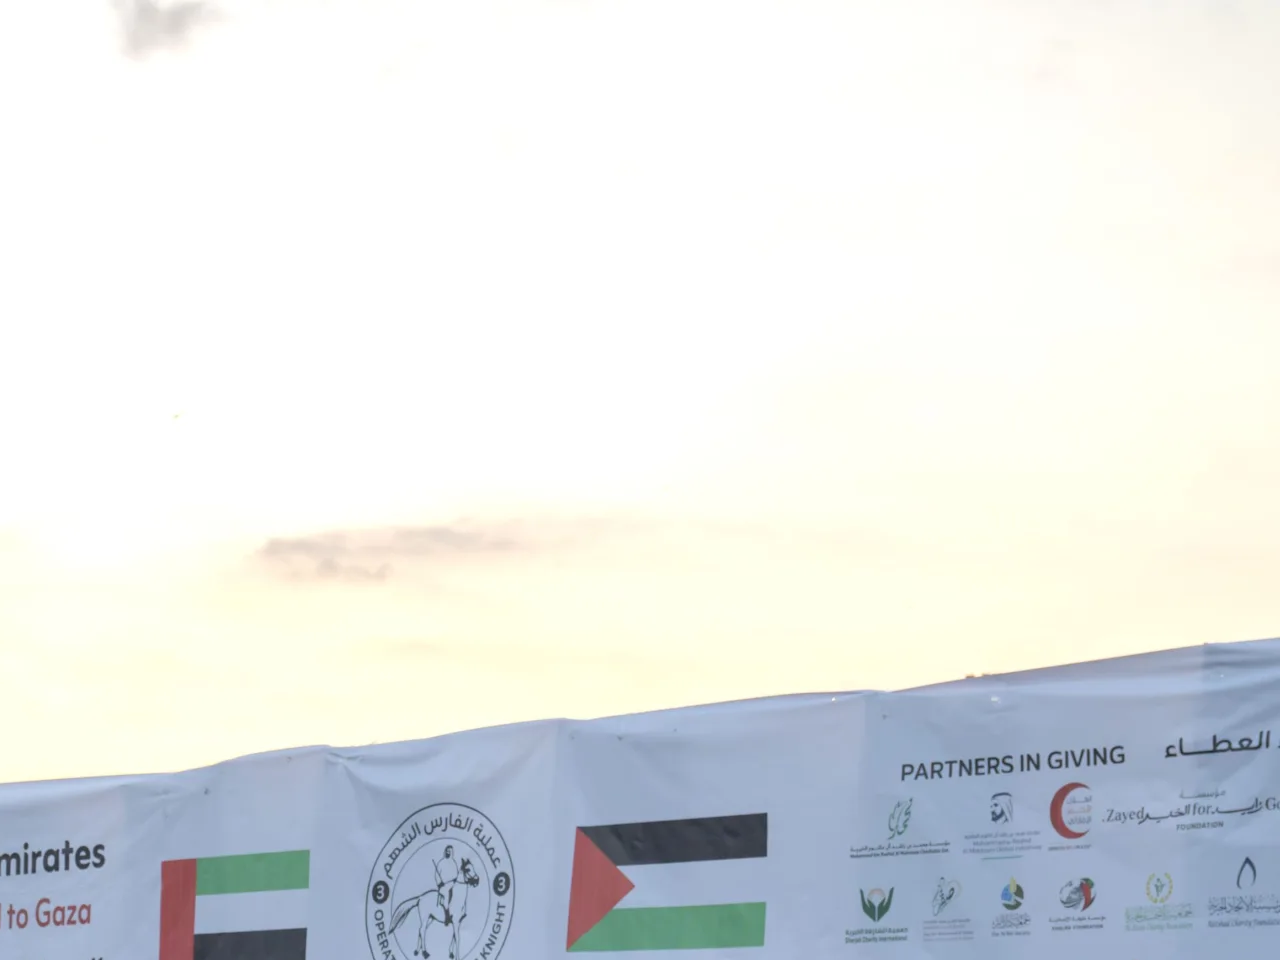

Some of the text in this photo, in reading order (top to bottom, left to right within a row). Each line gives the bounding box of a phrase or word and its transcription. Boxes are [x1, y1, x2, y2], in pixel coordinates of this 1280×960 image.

[1165, 730, 1271, 758] العطاء
[901, 745, 1126, 781] PARTNERS IN GIVING
[1176, 821, 1224, 831] FOUNDATION
[383, 812, 502, 880] عملية الفارس الشهم
[7, 907, 29, 929] to
[35, 897, 92, 928] Gaza
[480, 902, 507, 960] KNIGHT
